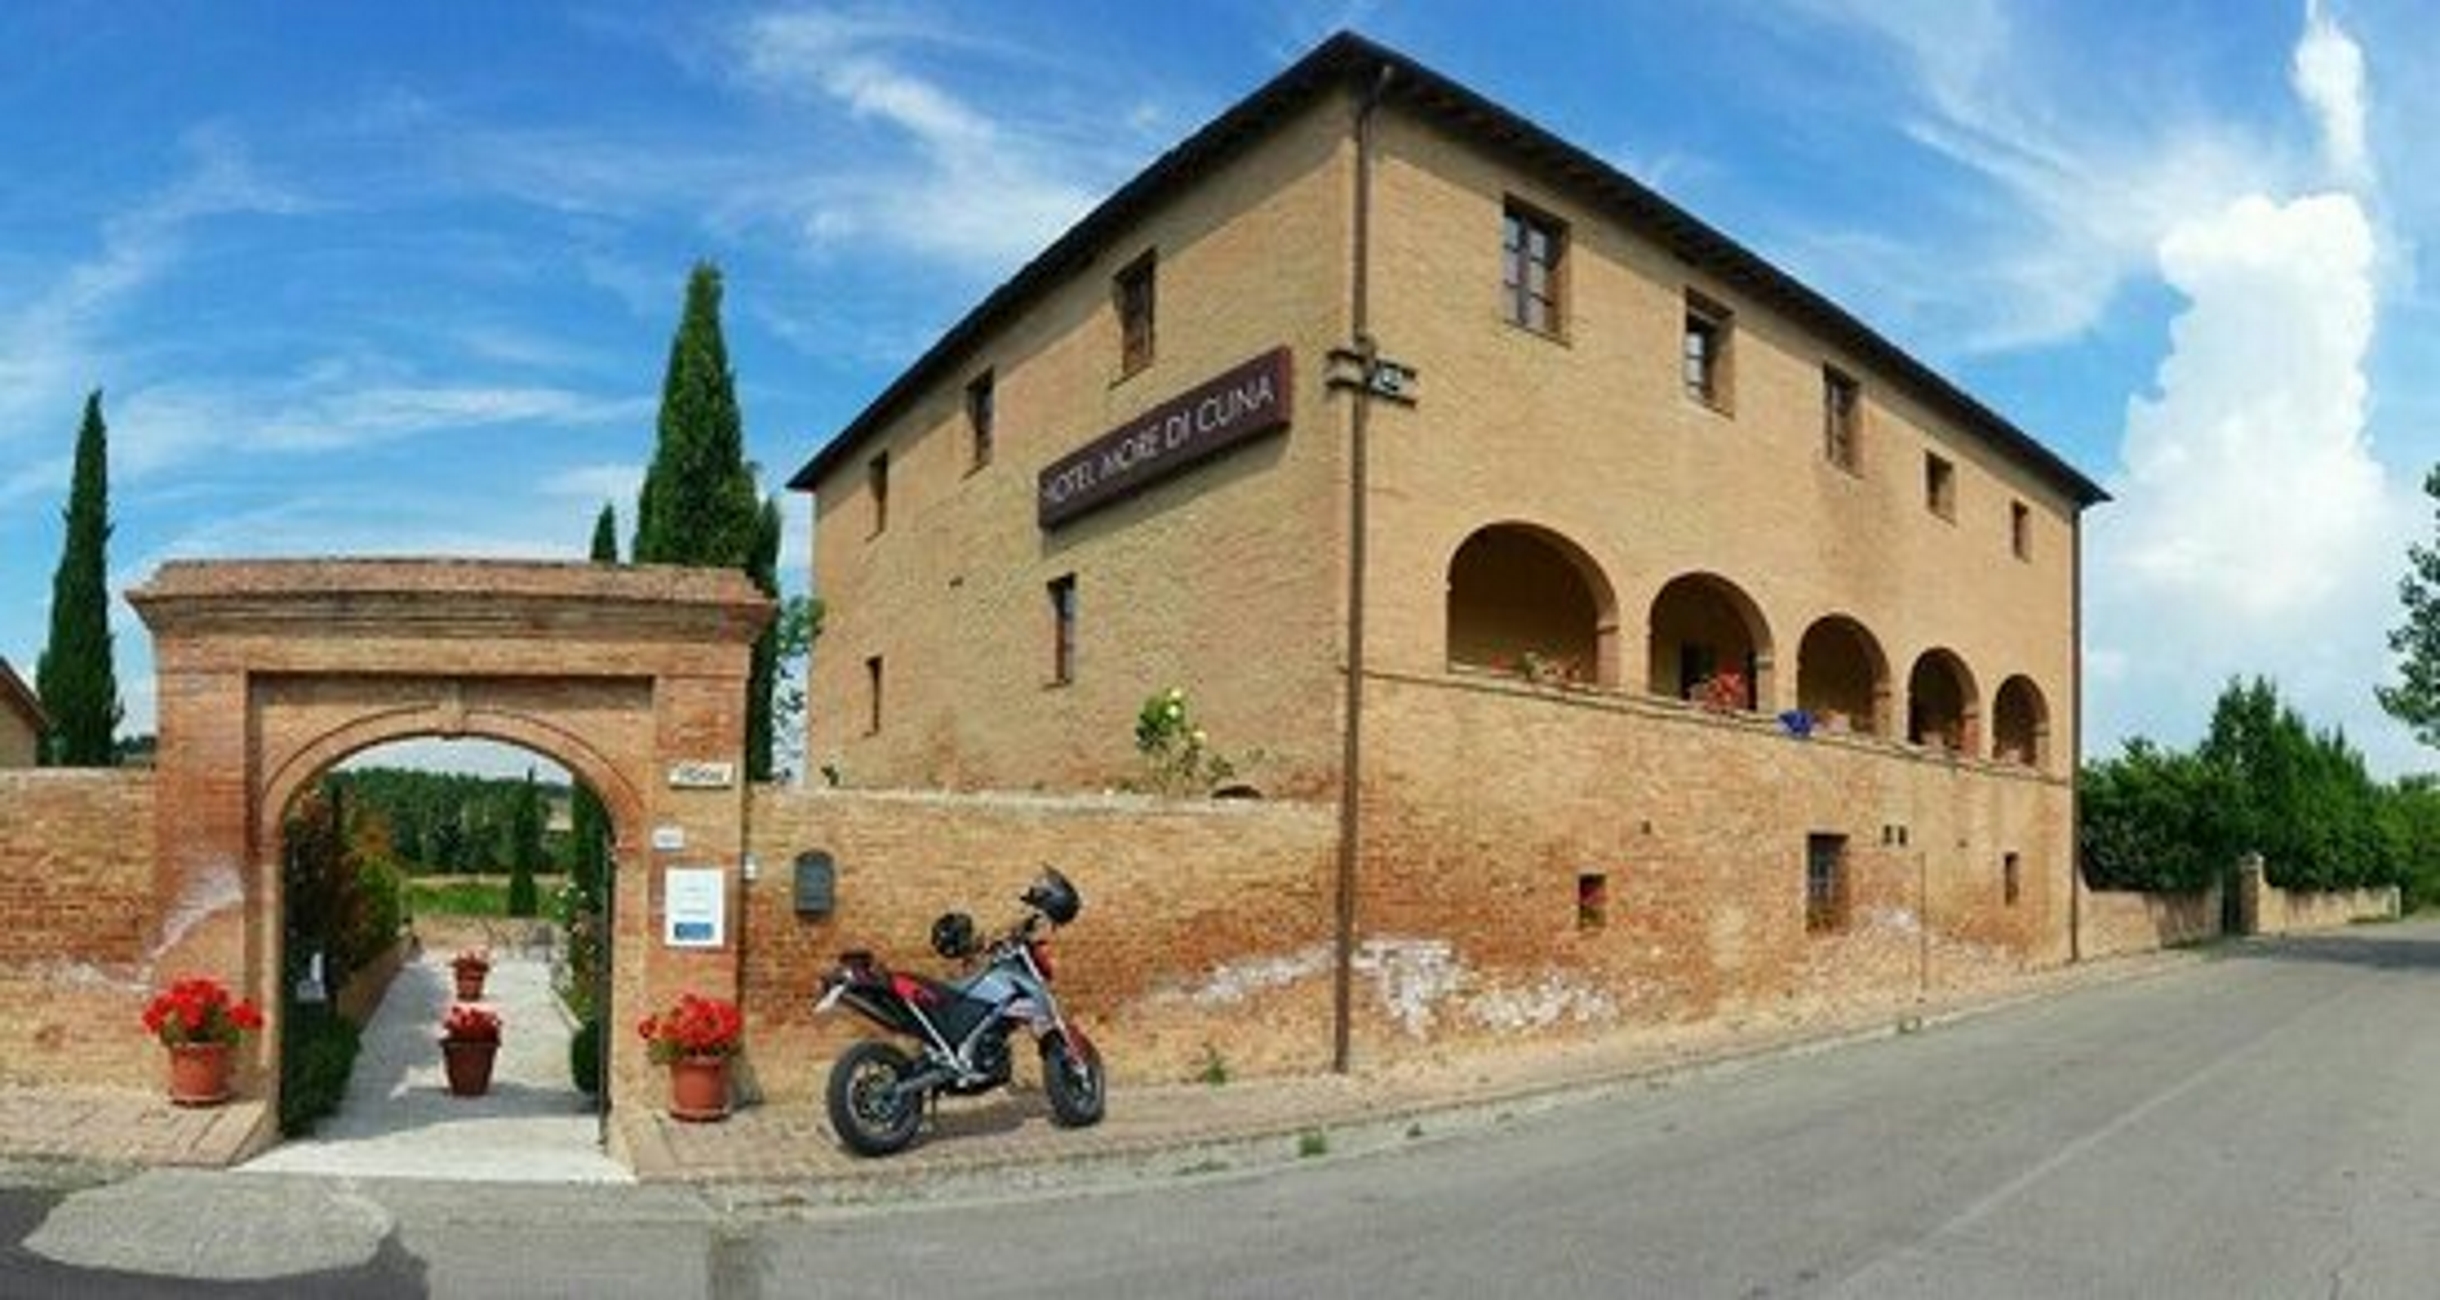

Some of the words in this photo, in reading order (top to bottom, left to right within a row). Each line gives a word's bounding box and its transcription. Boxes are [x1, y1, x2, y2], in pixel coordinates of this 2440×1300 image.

[1100, 424, 1160, 478] MORE
[1165, 410, 1191, 450] DI
[1197, 376, 1275, 432] CUNA
